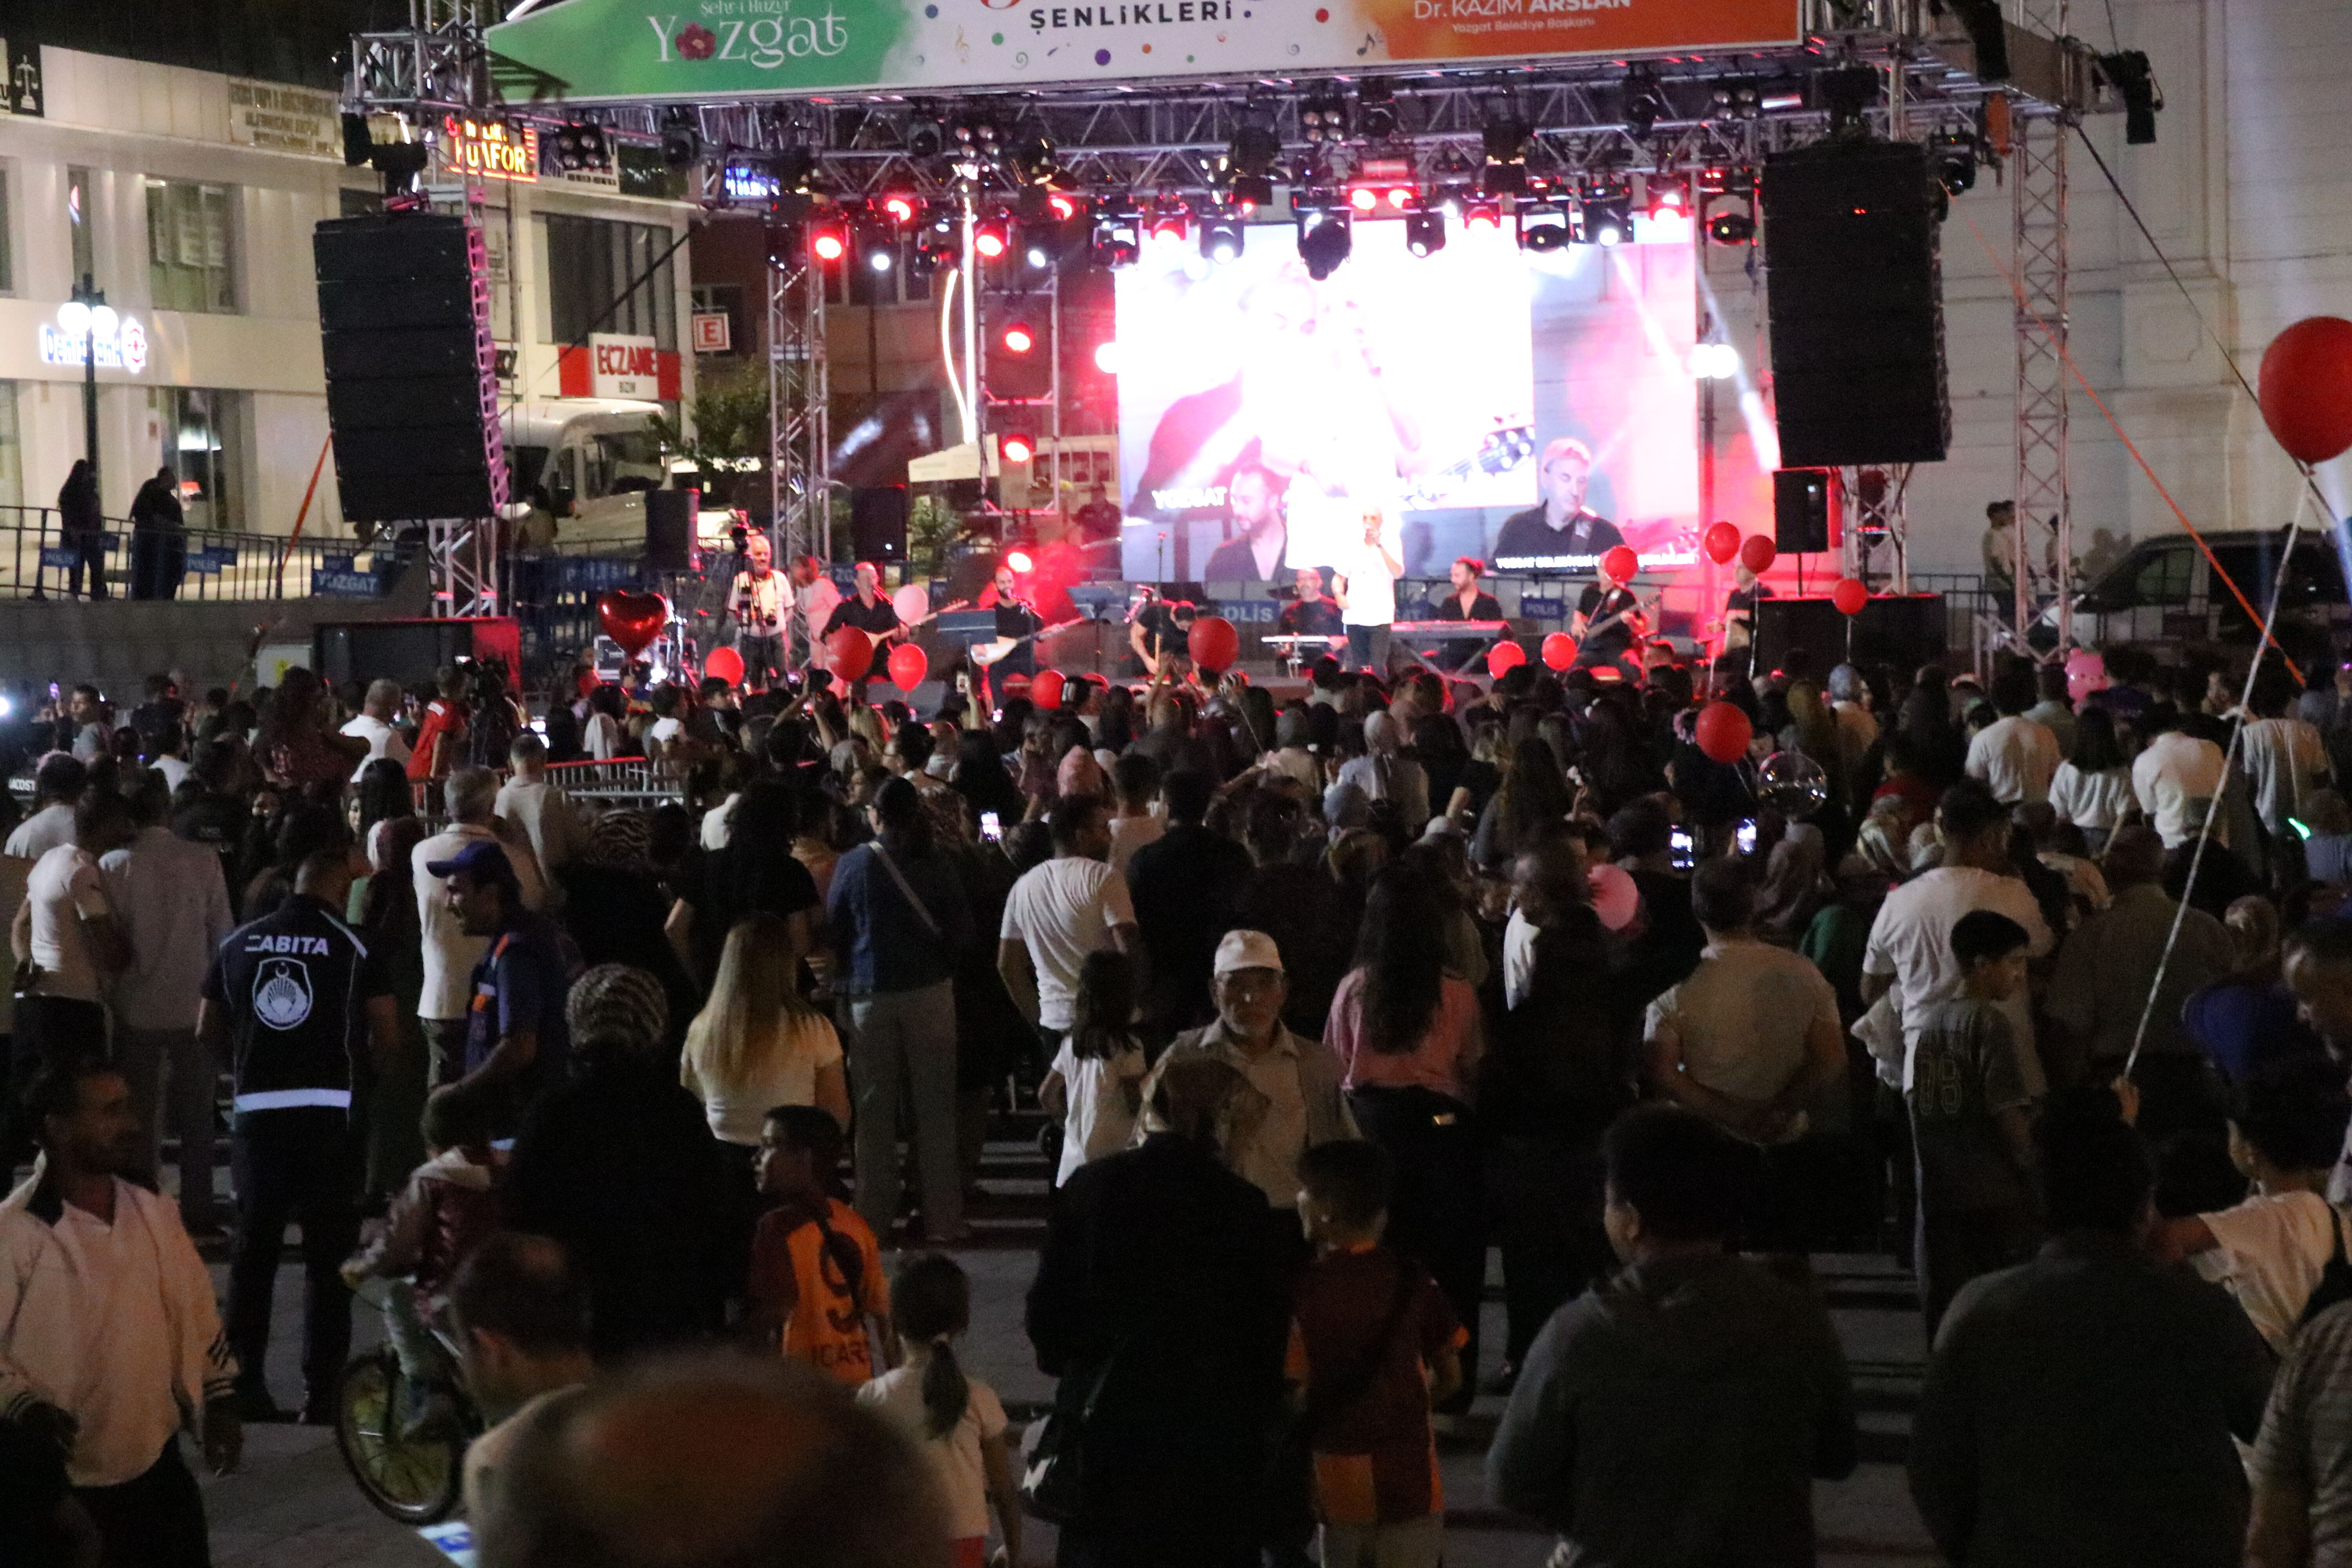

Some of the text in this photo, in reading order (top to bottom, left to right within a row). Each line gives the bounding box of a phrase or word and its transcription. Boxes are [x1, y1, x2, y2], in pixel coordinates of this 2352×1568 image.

[1414, 1, 1447, 19] Dr.
[704, 321, 718, 343] E
[597, 344, 657, 377] ECZANE
